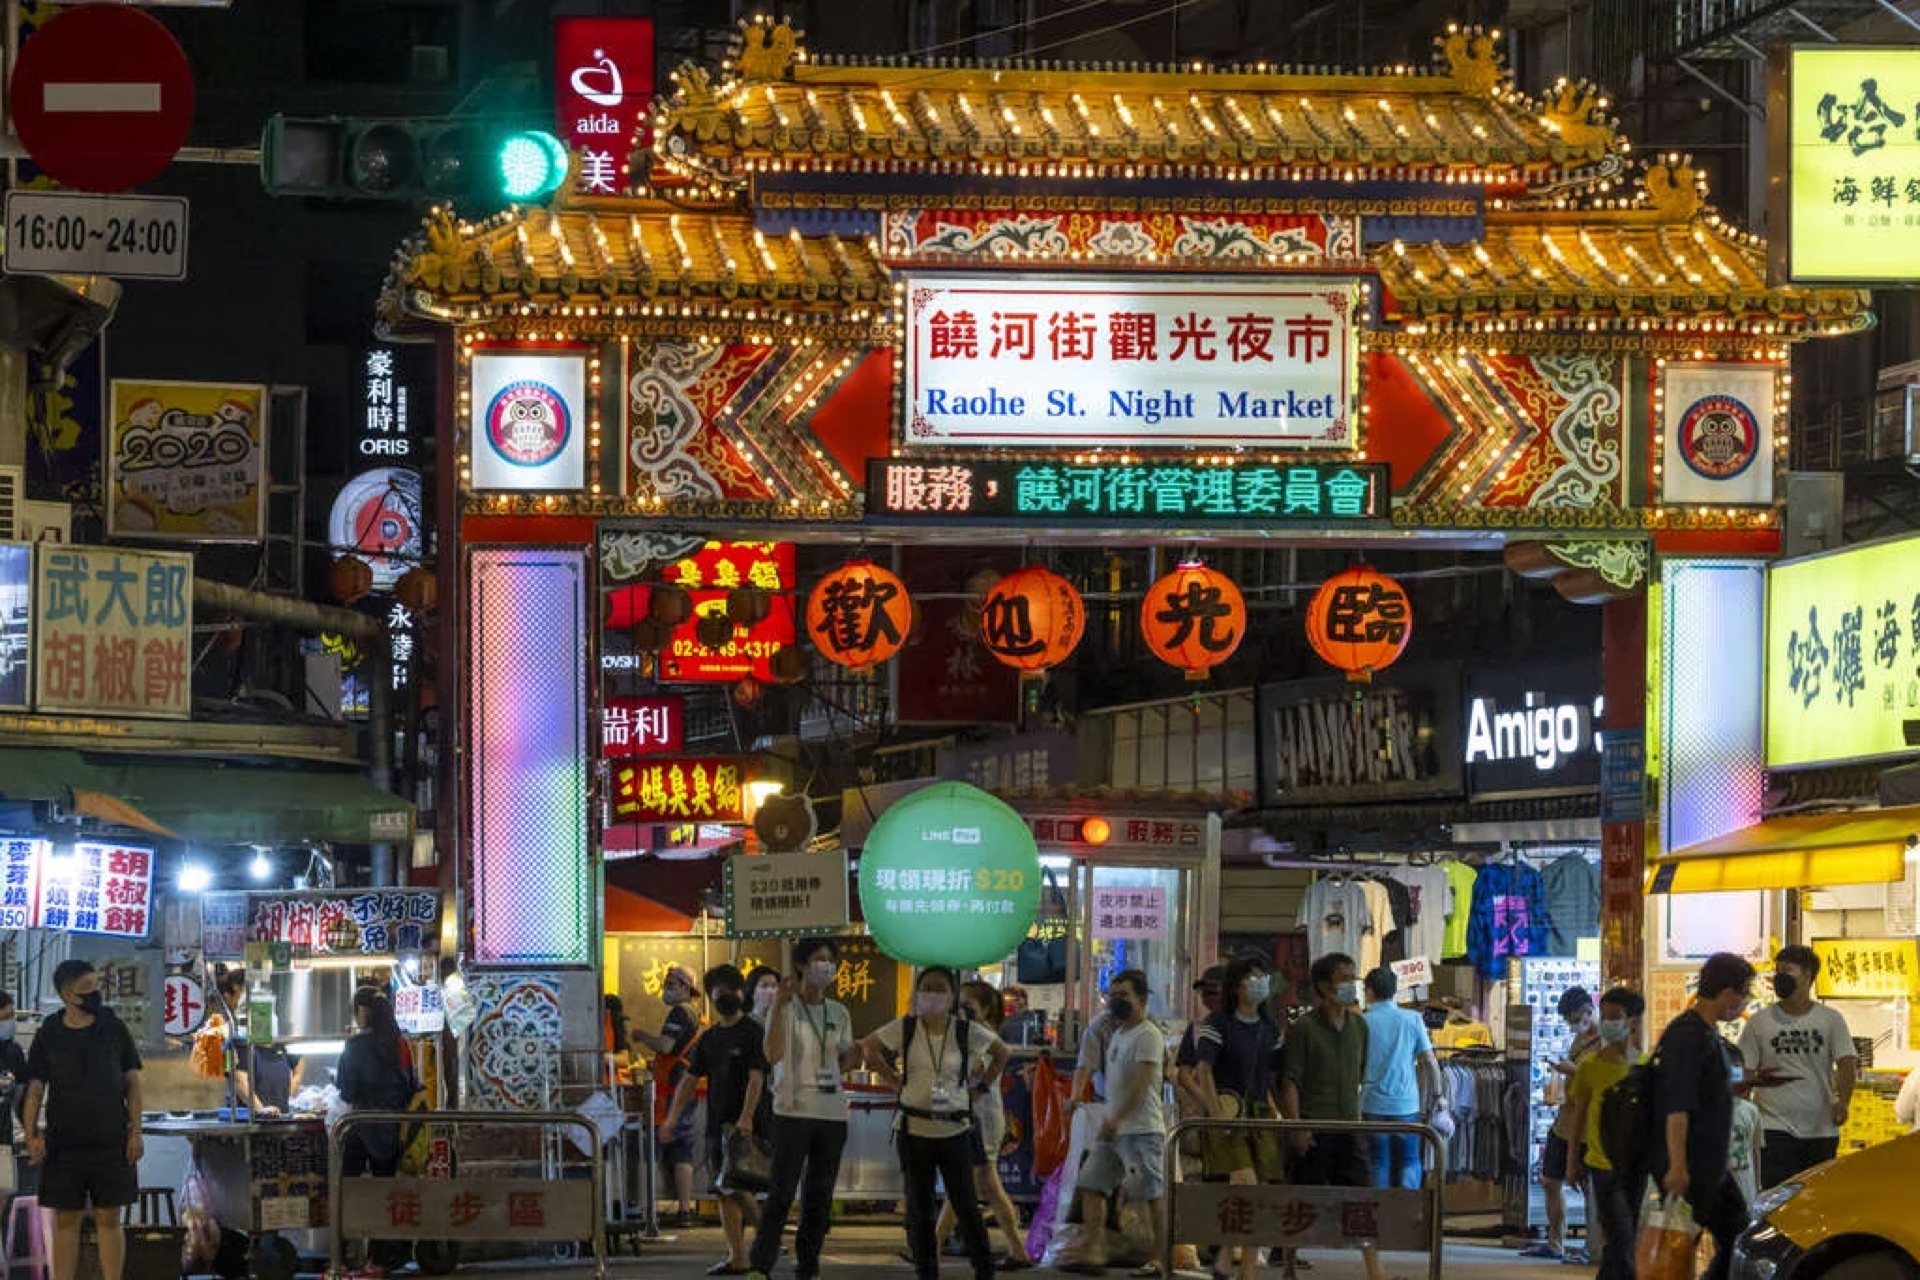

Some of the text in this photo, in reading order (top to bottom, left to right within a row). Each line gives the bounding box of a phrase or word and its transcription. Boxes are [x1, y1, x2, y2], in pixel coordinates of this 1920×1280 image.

[577, 112, 620, 133] aida
[1816, 78, 1920, 157] 哈
[581, 149, 615, 192] 美
[14, 213, 177, 255] 16:00~24:00
[929, 311, 1334, 364] 饒河街觀光夜市
[367, 350, 393, 432] 豪利時
[926, 388, 1335, 424] Raohe St. Night Market
[120, 427, 250, 472] 2020
[360, 439, 409, 455] ORIS
[46, 553, 187, 628] 武大郎
[817, 578, 902, 653] 歡
[1156, 582, 1235, 651] 光
[1325, 585, 1412, 647] 臨
[45, 631, 187, 705] 胡椒餅
[1466, 691, 1579, 770] Amigo
[617, 764, 742, 816] 三媽臭臭鍋
[103, 849, 149, 934] 胡椒餅
[386, 1189, 546, 1228] 徒步區
